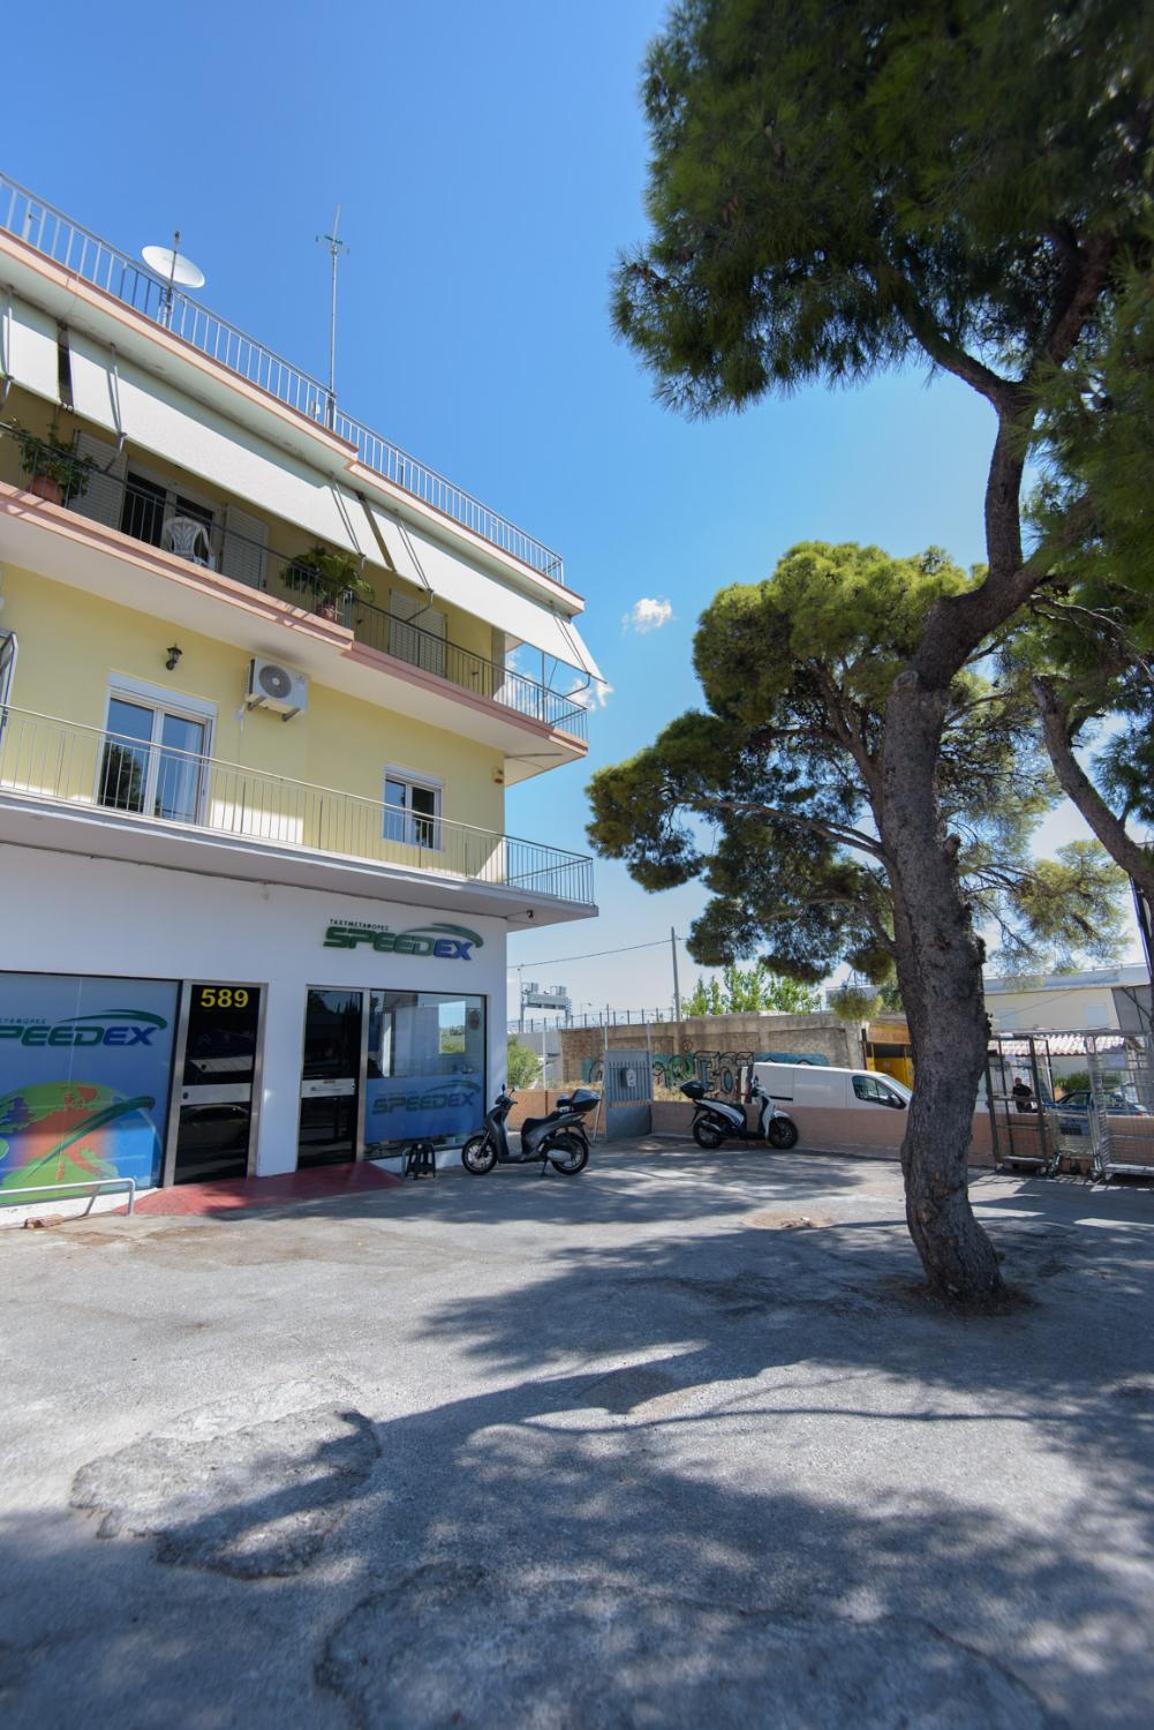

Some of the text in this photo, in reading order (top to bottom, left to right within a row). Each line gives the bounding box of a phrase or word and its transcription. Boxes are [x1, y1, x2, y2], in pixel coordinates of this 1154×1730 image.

[323, 926, 473, 960] SPEEDEX
[200, 988, 249, 1008] 589
[0, 1025, 157, 1046] PEEDEX
[372, 1092, 474, 1115] SPEEDEX
